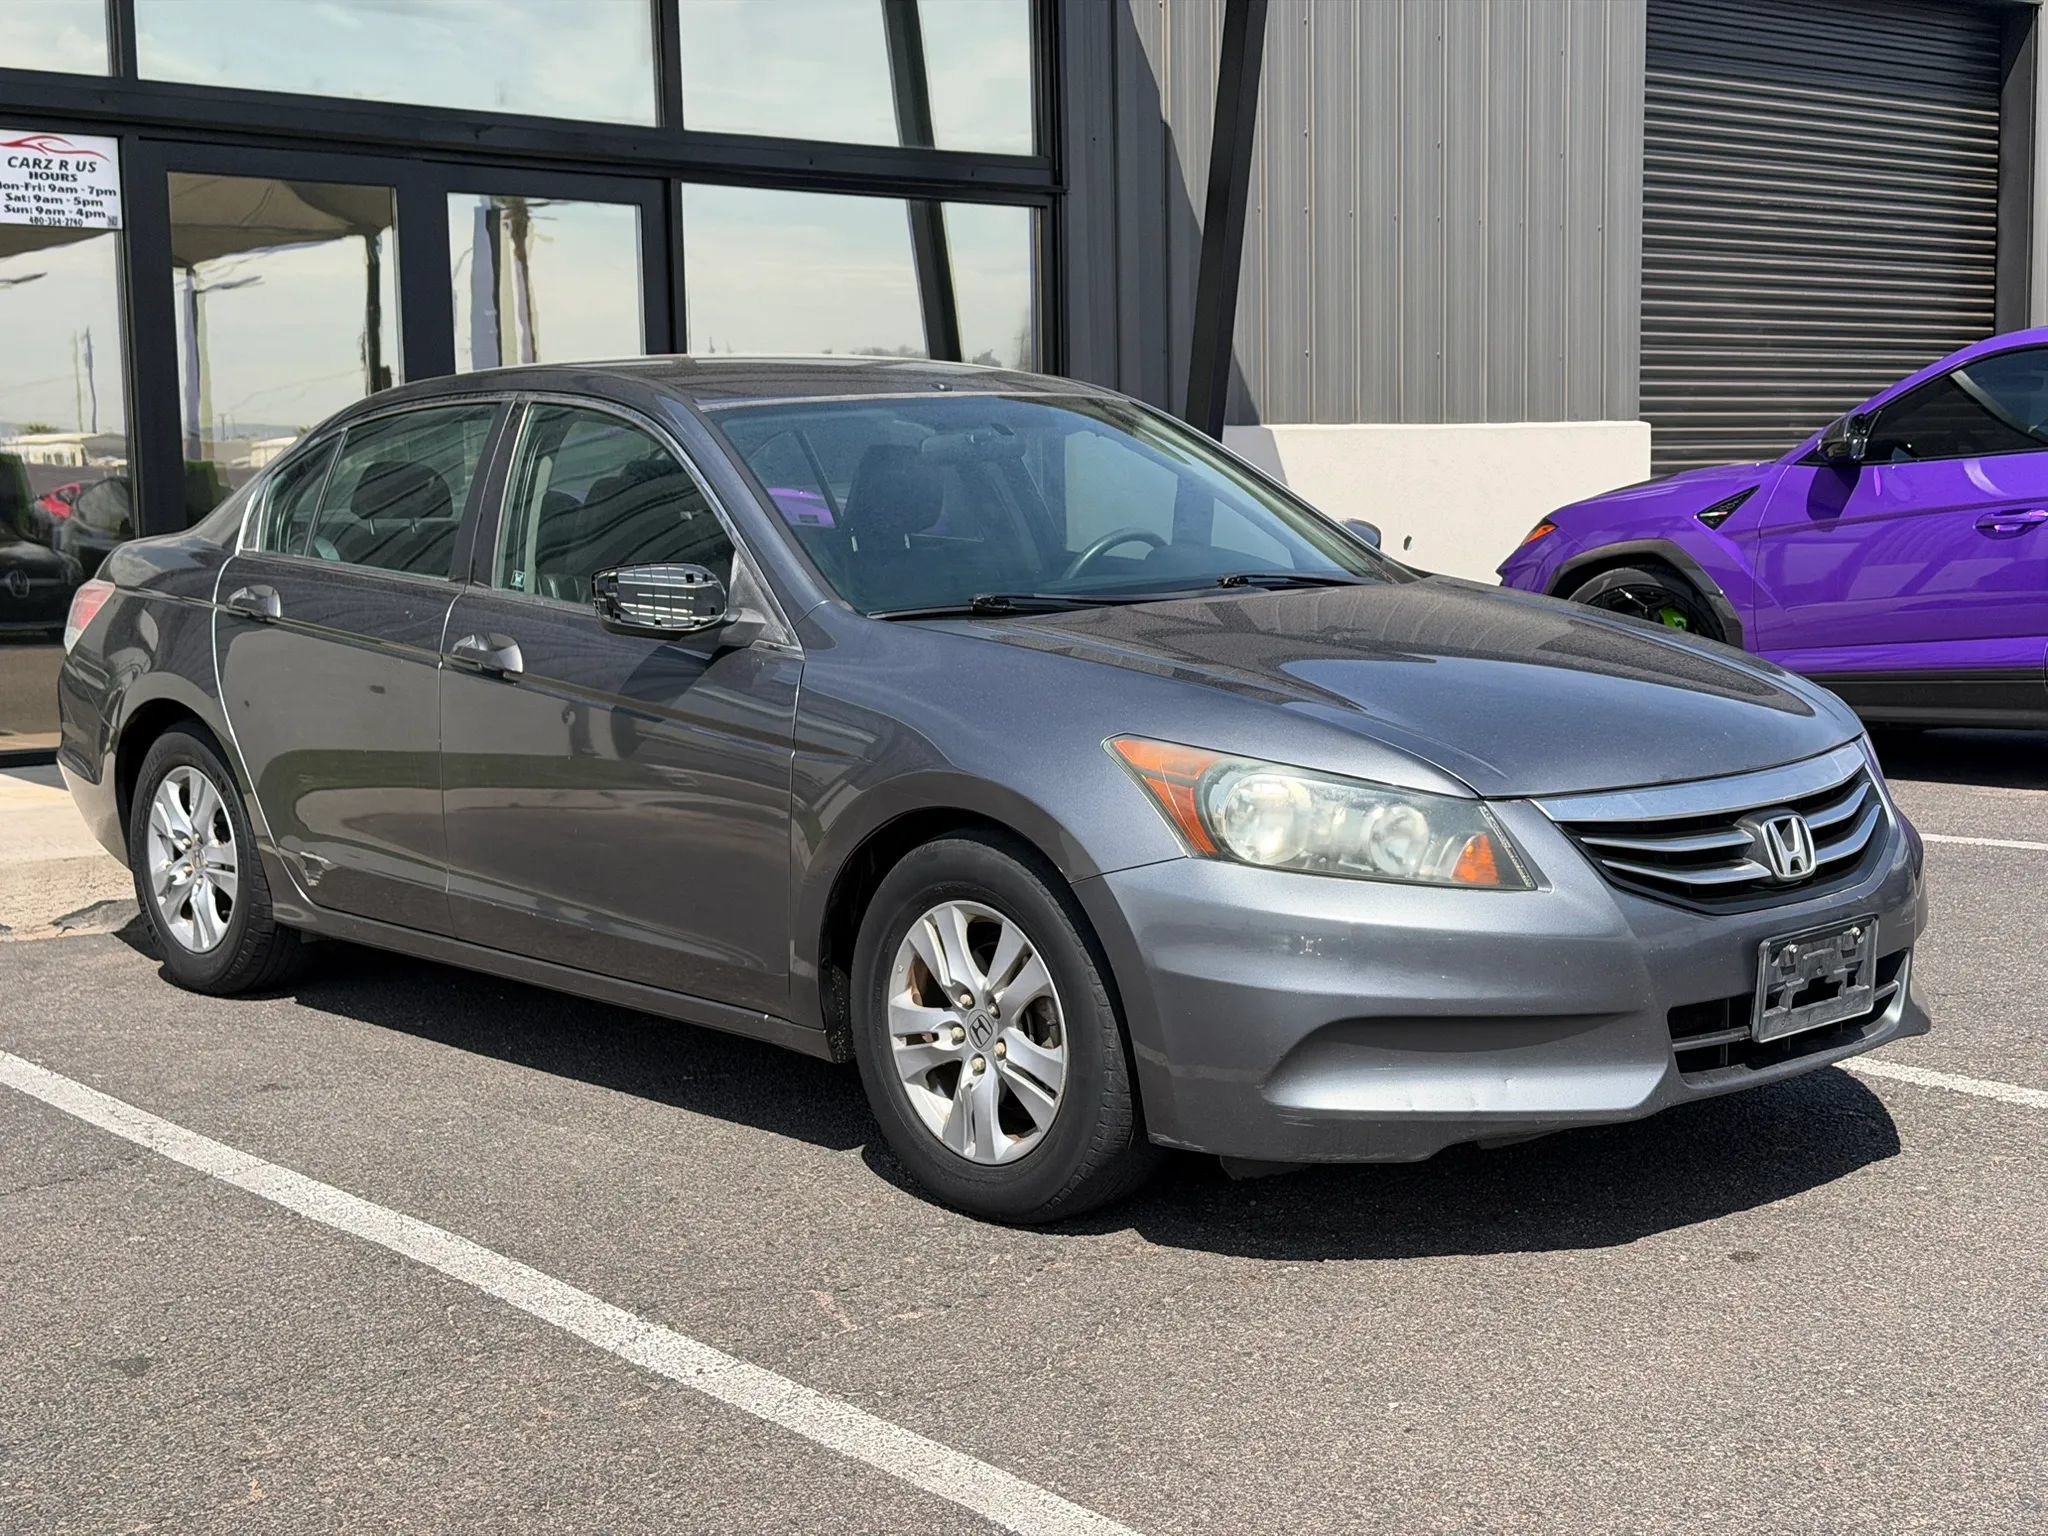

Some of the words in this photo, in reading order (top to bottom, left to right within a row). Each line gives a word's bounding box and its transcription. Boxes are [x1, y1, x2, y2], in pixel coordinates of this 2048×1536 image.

[7, 156, 54, 170] CARZ
[59, 160, 69, 171] R
[75, 160, 97, 173] US
[29, 171, 78, 182] HOURS
[48, 184, 78, 194] 9am
[88, 186, 117, 196] 7pm
[5, 193, 31, 203] Sat:
[33, 194, 63, 205] 9am
[73, 196, 104, 207] 5pm
[4, 204, 33, 214] Sun:
[35, 206, 65, 216] 9am
[76, 208, 106, 219] 4pm
